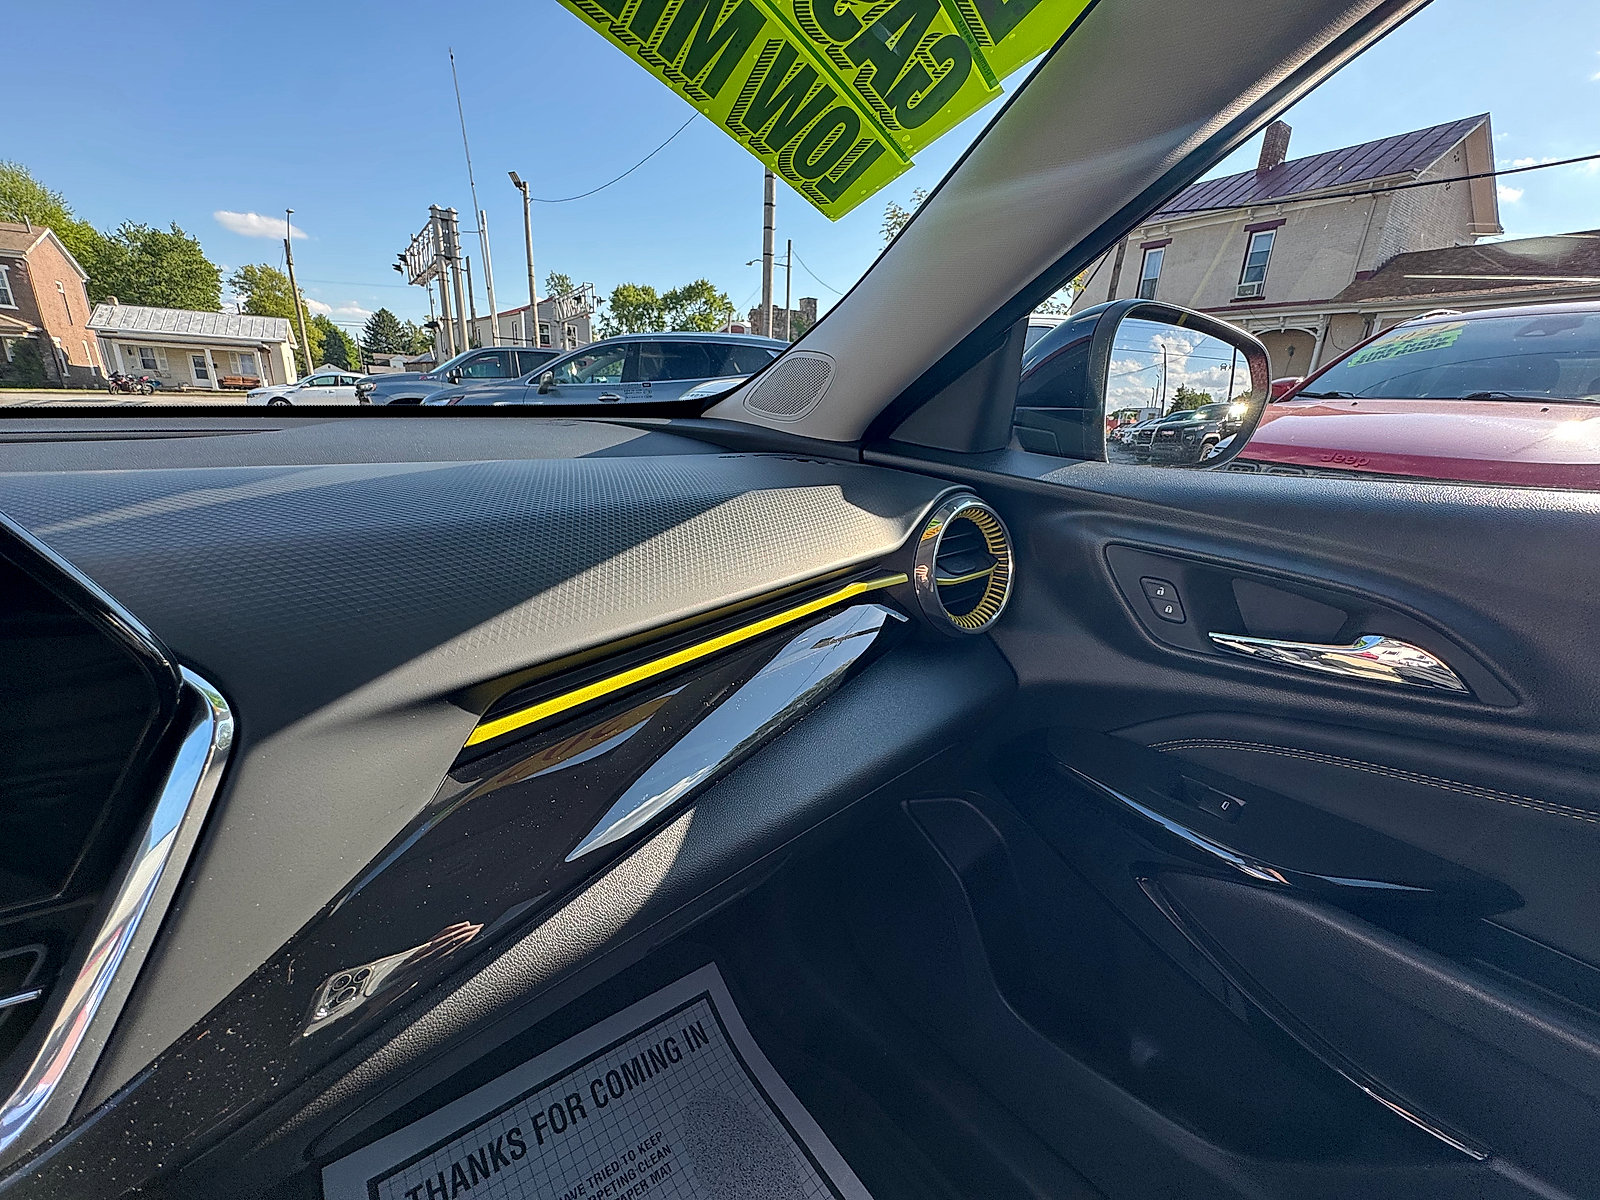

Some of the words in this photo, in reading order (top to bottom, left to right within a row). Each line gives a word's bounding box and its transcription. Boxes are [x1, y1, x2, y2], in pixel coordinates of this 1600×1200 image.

[1321, 452, 1370, 468] Jeep
[404, 1127, 527, 1200] THANKS
[531, 1092, 588, 1145] FOR
[590, 1036, 683, 1109] COMING
[682, 1020, 710, 1053] IN
[559, 1183, 587, 1200] AVE
[586, 1161, 620, 1189] TRIED
[620, 1149, 636, 1165] TO
[637, 1131, 662, 1155] KEEP
[637, 1144, 672, 1173] CLEAN
[649, 1162, 673, 1184] MAT
